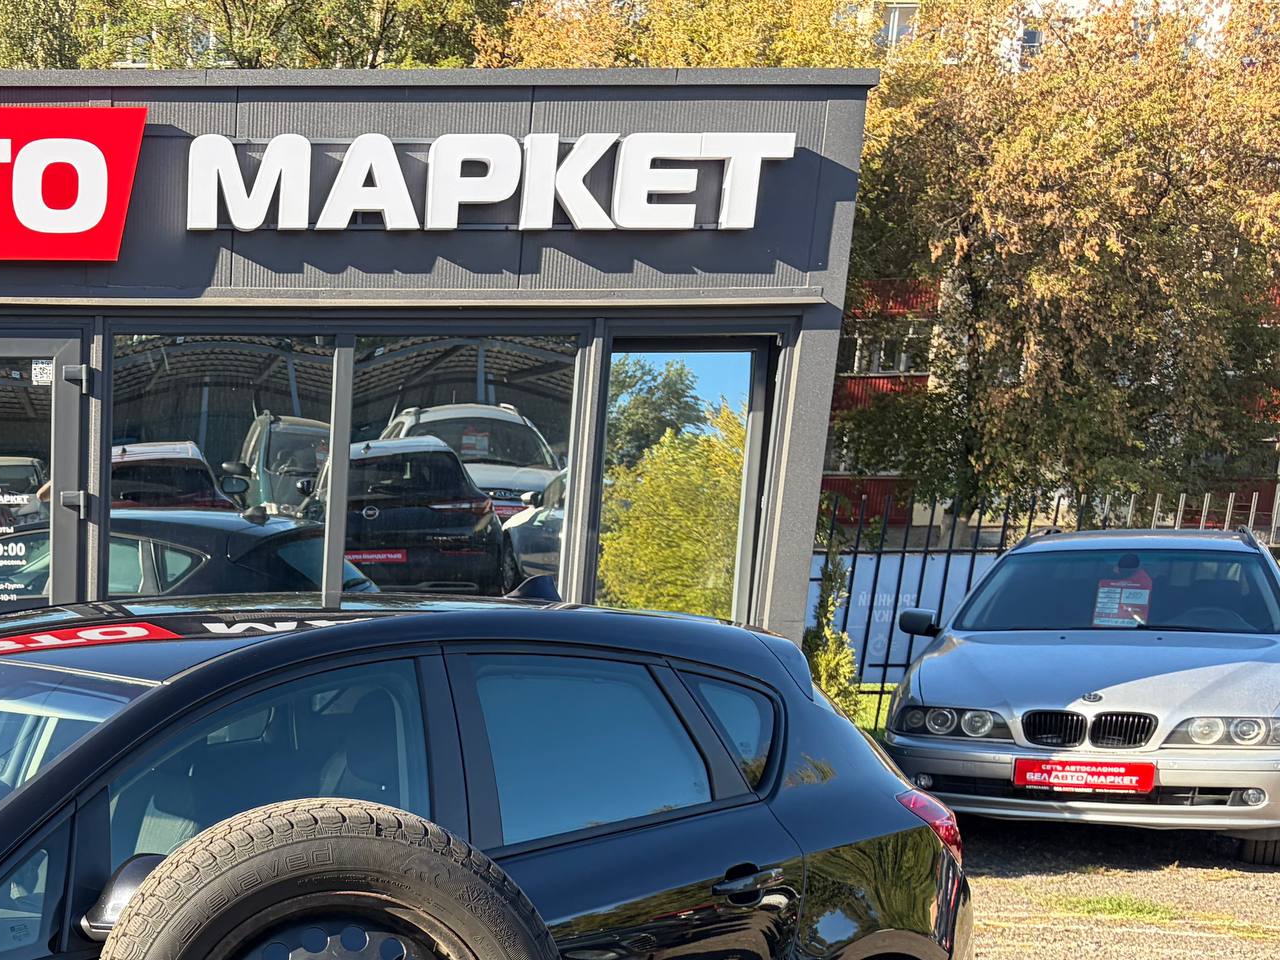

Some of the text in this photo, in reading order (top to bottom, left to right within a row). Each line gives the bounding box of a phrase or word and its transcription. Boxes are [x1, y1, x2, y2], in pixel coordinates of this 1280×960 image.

[186, 132, 797, 232] МАРКЕТ
[1064, 765, 1126, 773] АВТОСАЛОНОВ
[1026, 772, 1139, 785] БЕЛ АВТО МАРКЕТ
